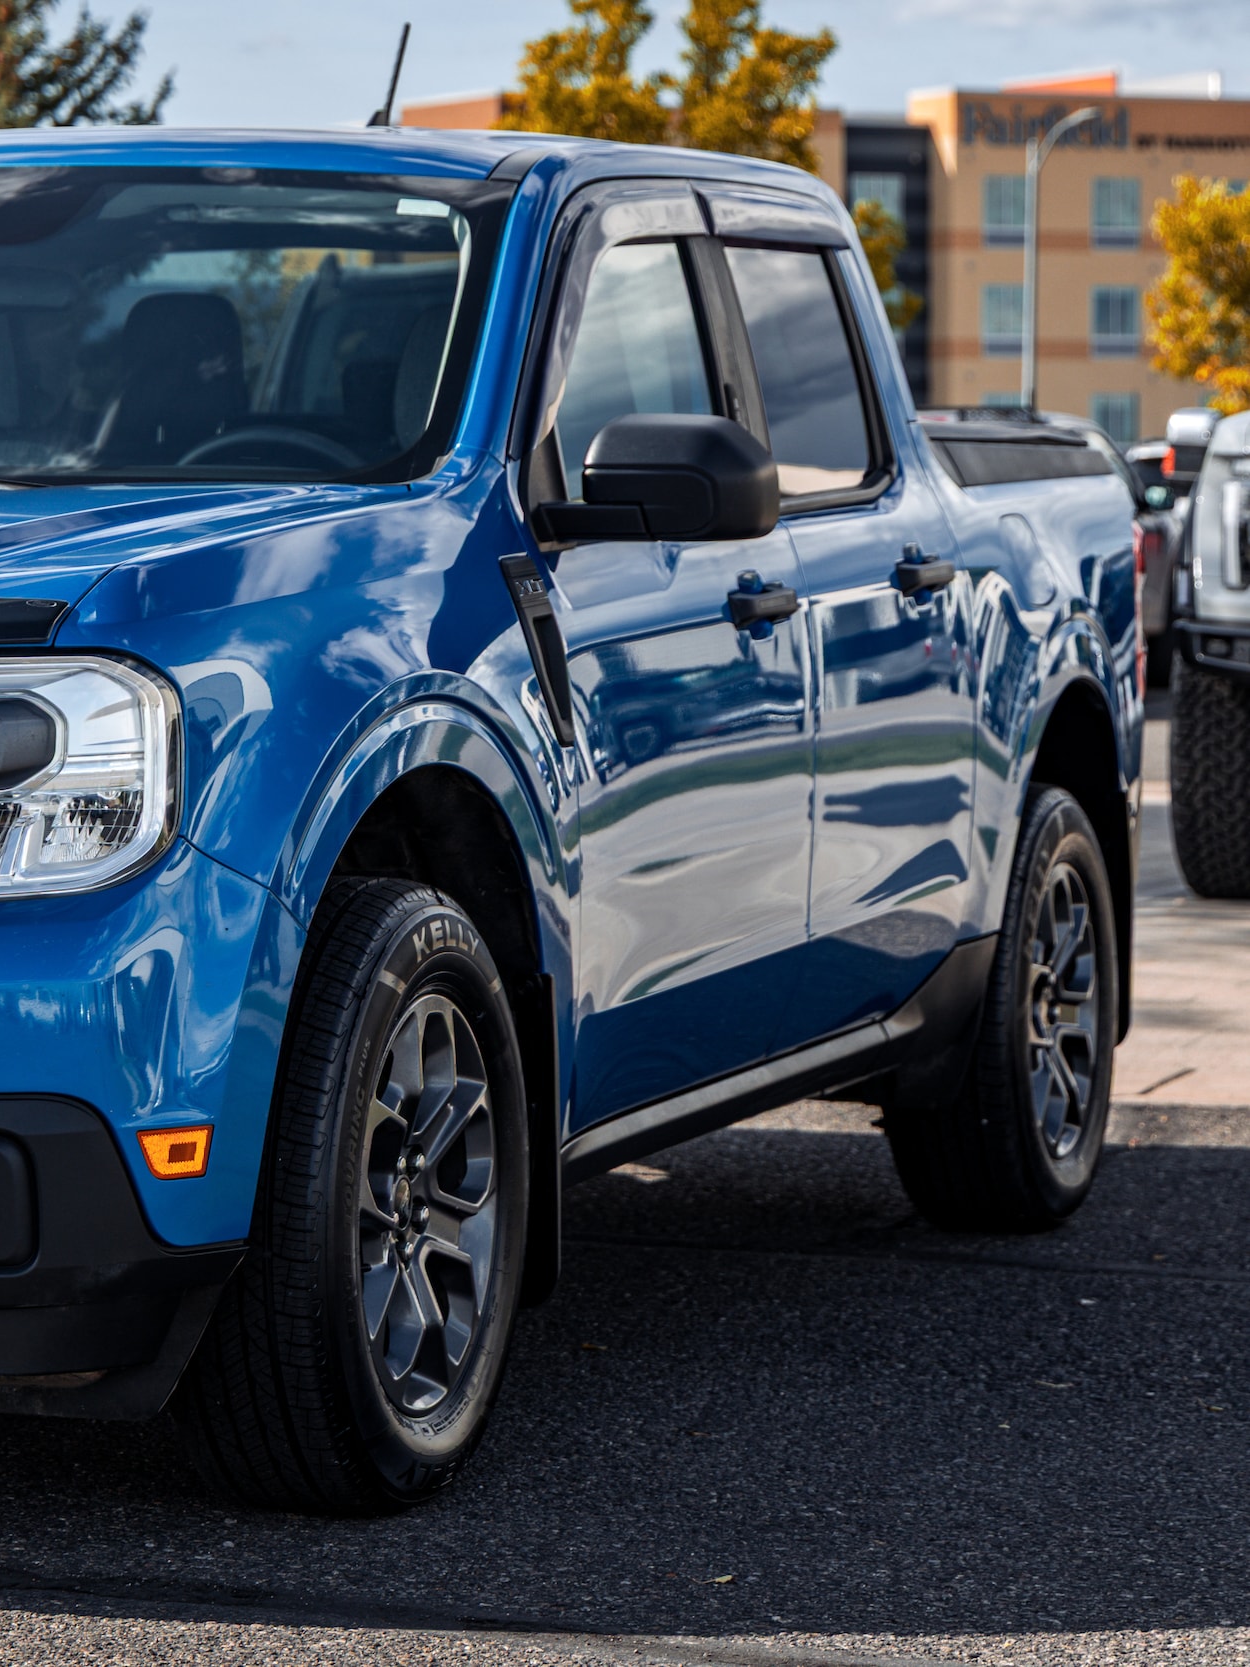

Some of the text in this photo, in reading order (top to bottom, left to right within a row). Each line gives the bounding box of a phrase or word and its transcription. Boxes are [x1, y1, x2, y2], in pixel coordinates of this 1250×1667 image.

[514, 578, 544, 597] XLT
[412, 919, 479, 963] KELLY
[358, 1037, 371, 1078] PLUS
